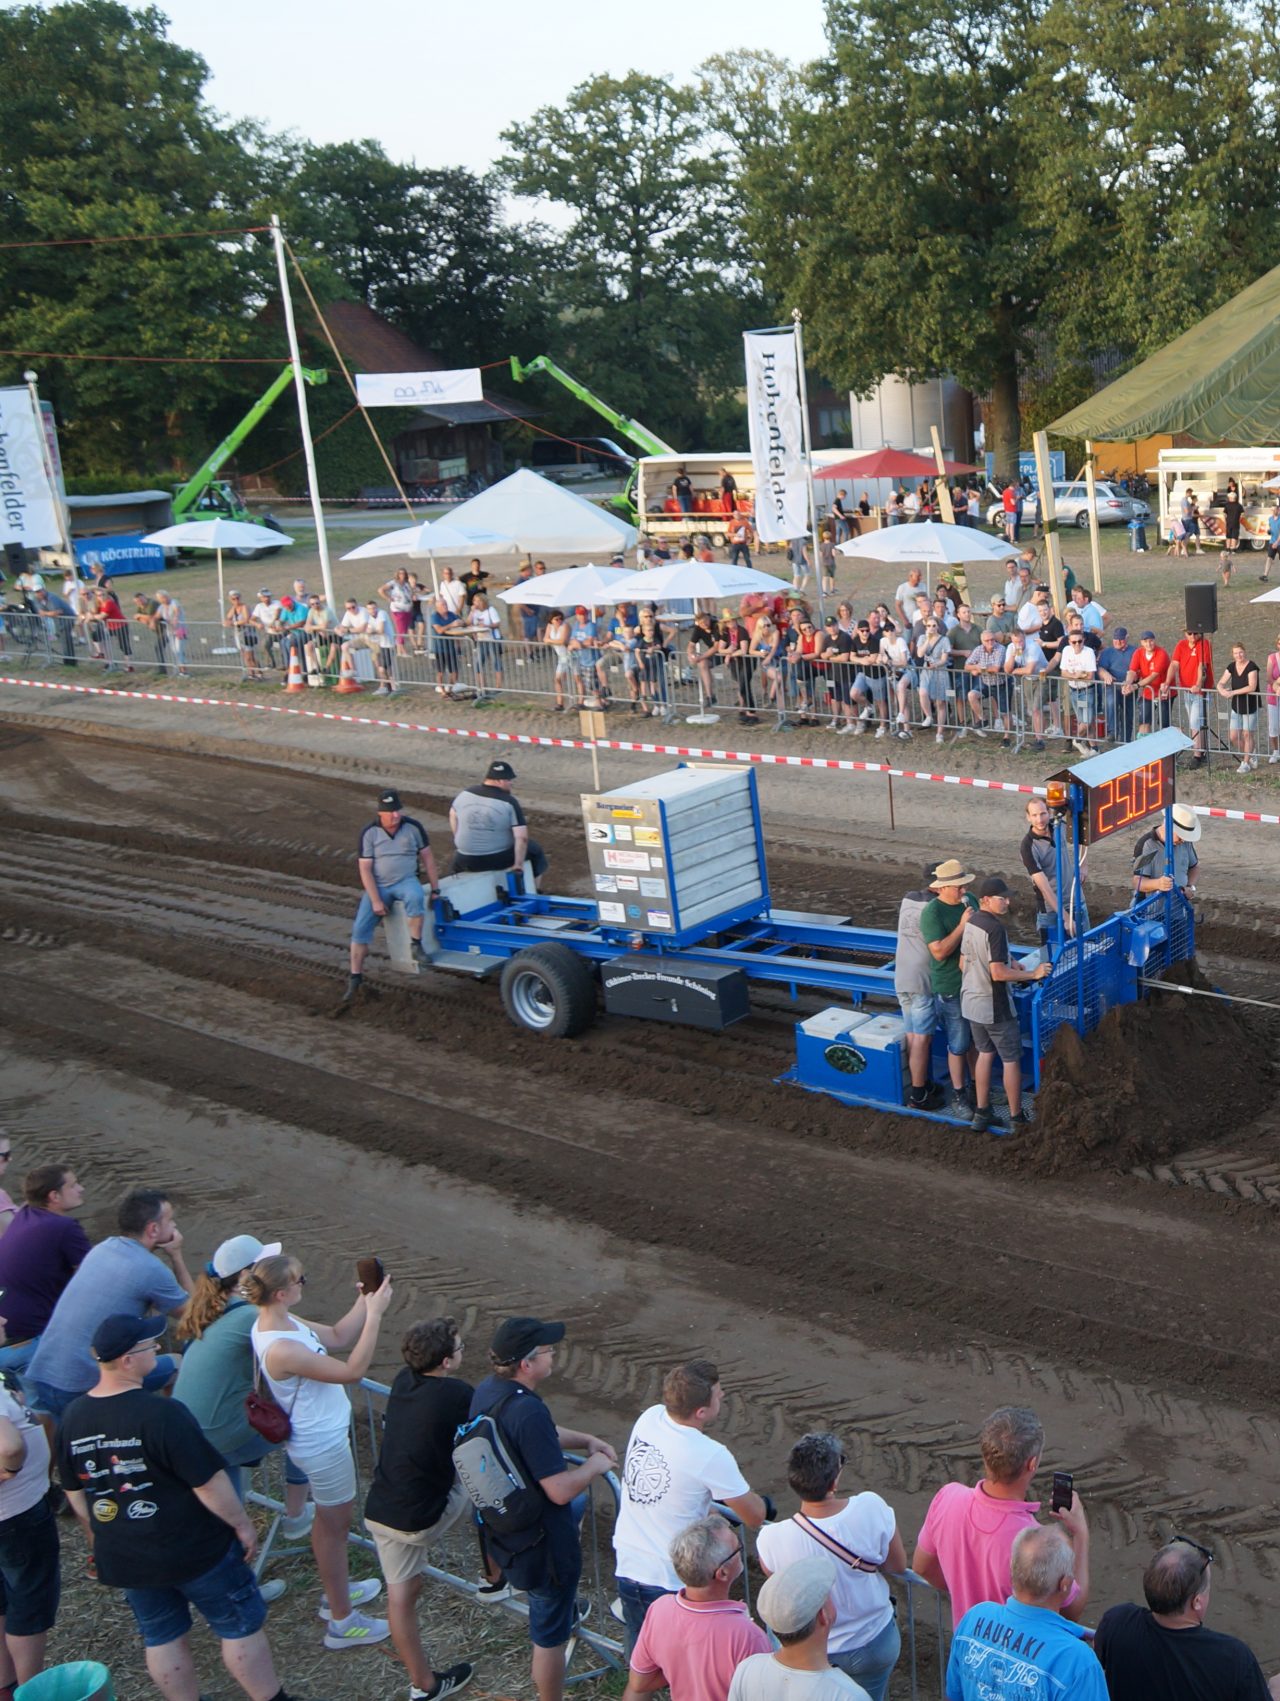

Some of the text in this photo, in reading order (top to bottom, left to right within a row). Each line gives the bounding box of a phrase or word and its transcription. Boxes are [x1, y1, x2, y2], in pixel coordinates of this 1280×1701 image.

[762, 351, 786, 525] Hohenfelder
[1099, 758, 1162, 834] 25.09
[973, 1616, 1046, 1660] HAURAKI
